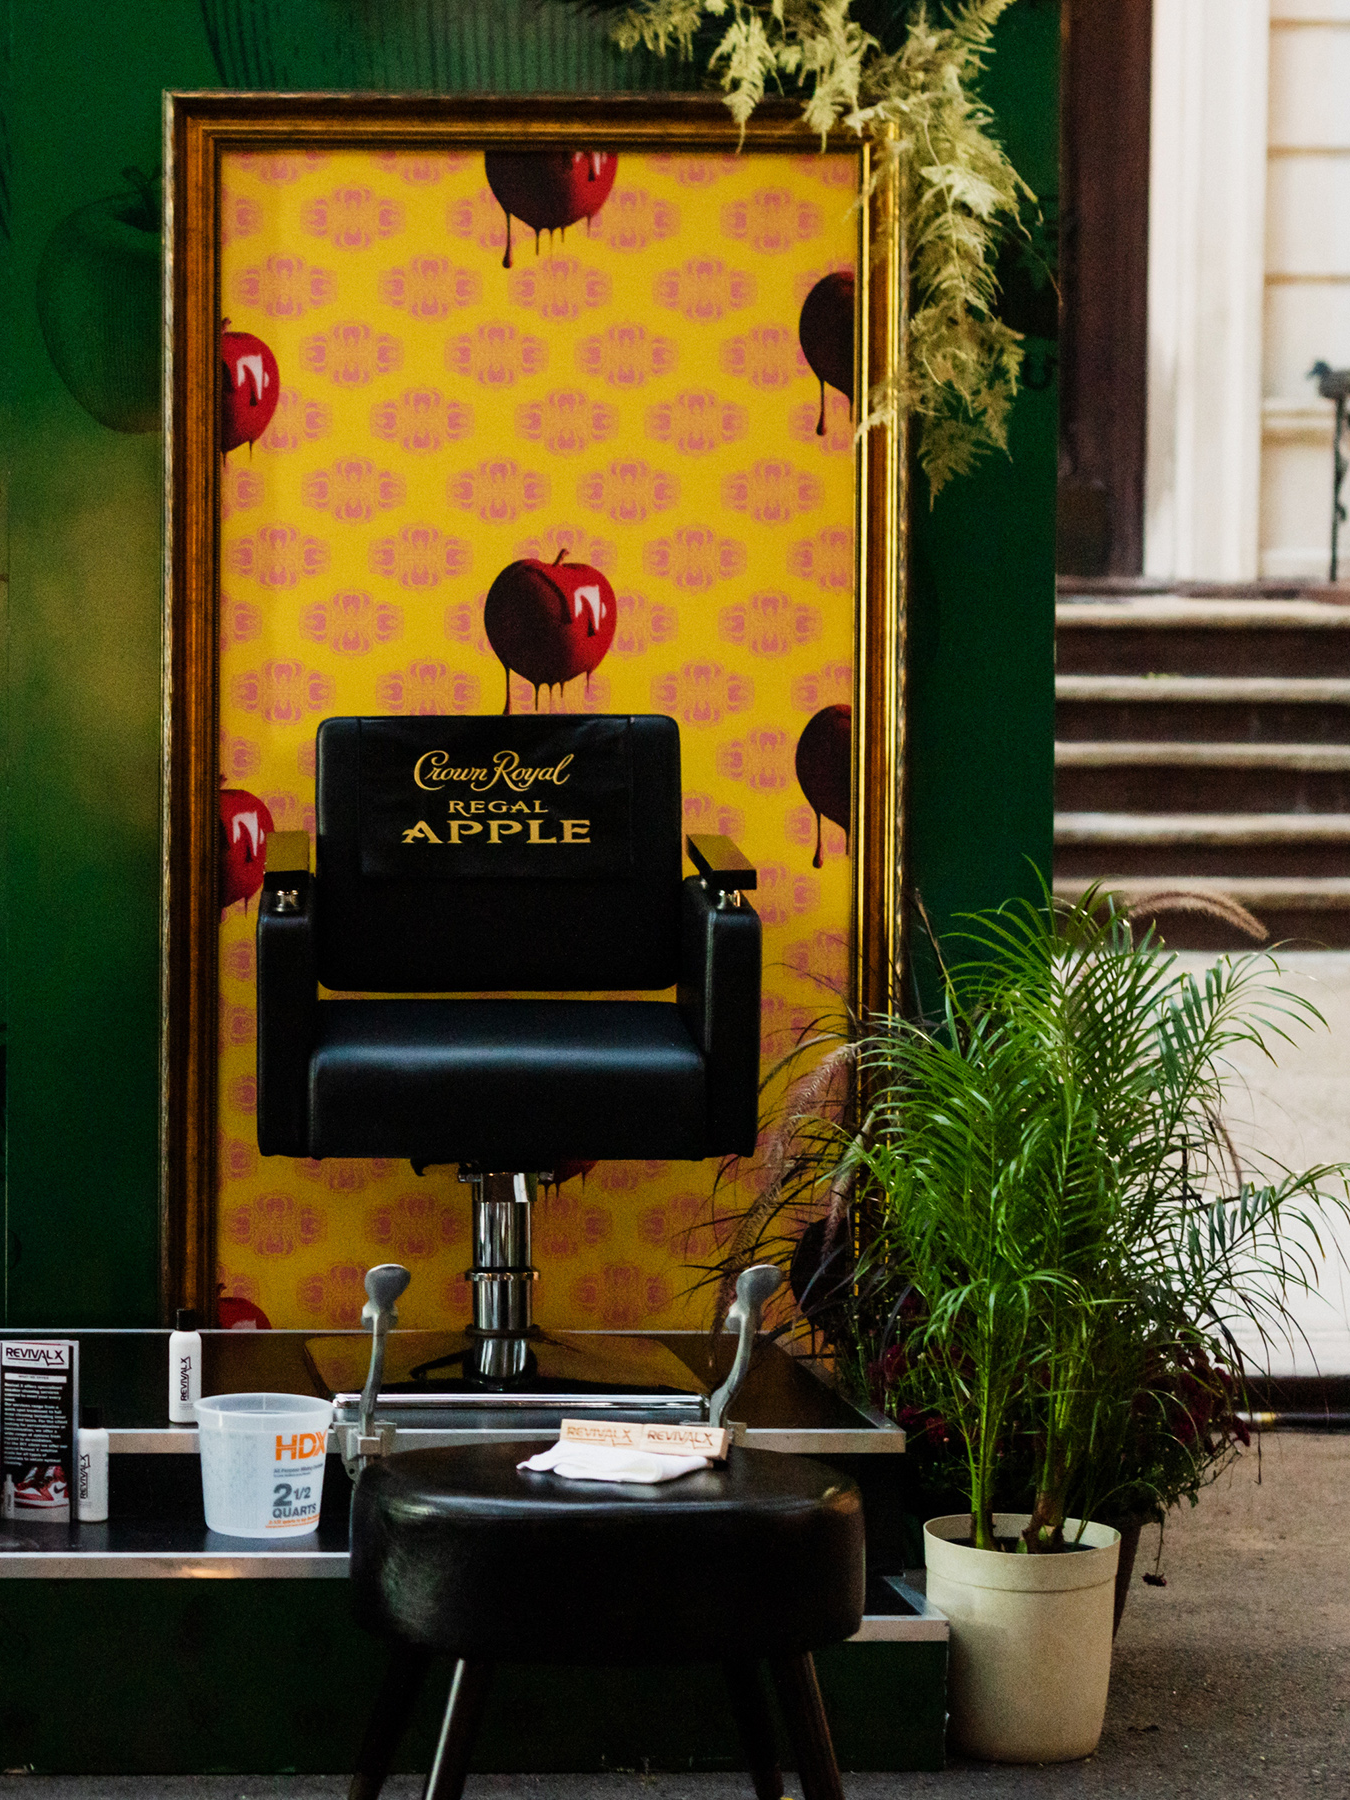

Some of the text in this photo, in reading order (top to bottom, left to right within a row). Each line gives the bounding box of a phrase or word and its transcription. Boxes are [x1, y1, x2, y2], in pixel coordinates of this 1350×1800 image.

[414, 750, 575, 792] Crown Royal
[448, 800, 549, 817] REGAL
[401, 819, 592, 844] APPLE
[275, 1430, 327, 1461] HDX
[273, 1483, 311, 1507] 2 1/2
[272, 1503, 316, 1519] QUARTS
